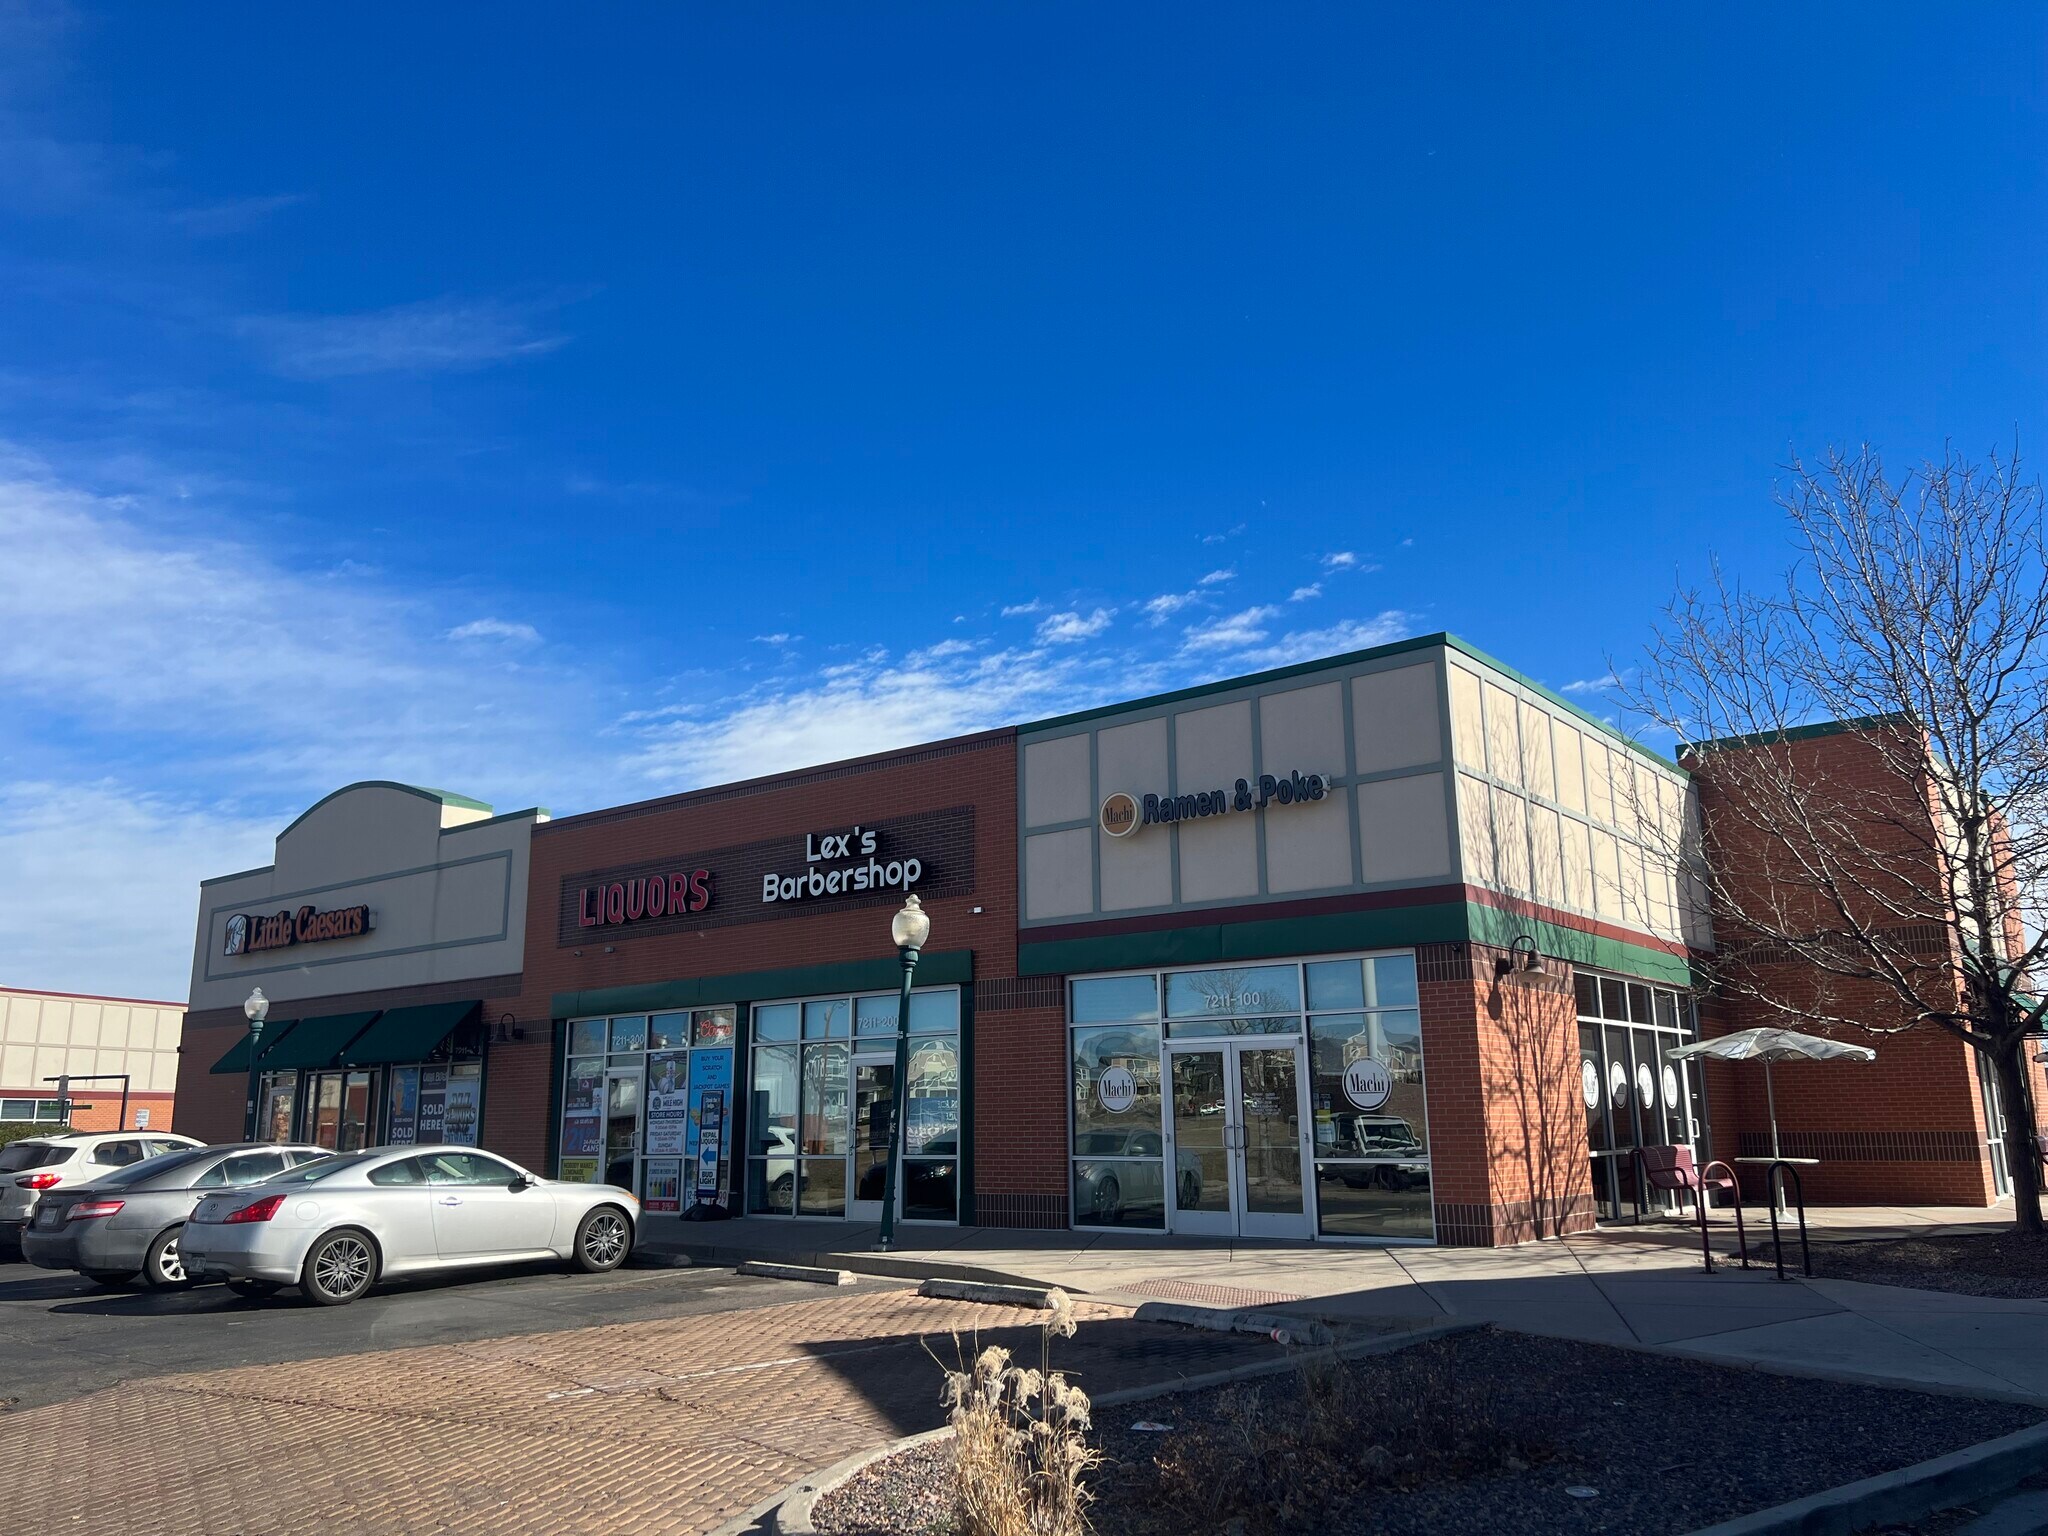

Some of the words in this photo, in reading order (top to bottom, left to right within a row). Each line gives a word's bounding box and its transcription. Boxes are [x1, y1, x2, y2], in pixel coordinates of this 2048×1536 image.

[1104, 804, 1134, 824] Machi
[1143, 788, 1227, 825] Ramen
[1234, 778, 1253, 812] &
[1259, 769, 1324, 808] Poke
[806, 826, 877, 862] Lex's
[762, 857, 922, 903] Barbershop
[578, 869, 710, 928] LIQUORS
[248, 911, 292, 950] Little
[1204, 991, 1261, 1010] 7211-100
[857, 1015, 898, 1030] 7211-200
[612, 1033, 645, 1047] 7211-300
[1103, 1079, 1132, 1098] Machi
[1349, 1072, 1386, 1094] Machi
[422, 1104, 444, 1116] SOLD
[650, 1111, 666, 1119] STORE
[666, 1110, 683, 1118] HOURS
[391, 1127, 414, 1139] SOLD
[582, 1144, 599, 1152] CANS
